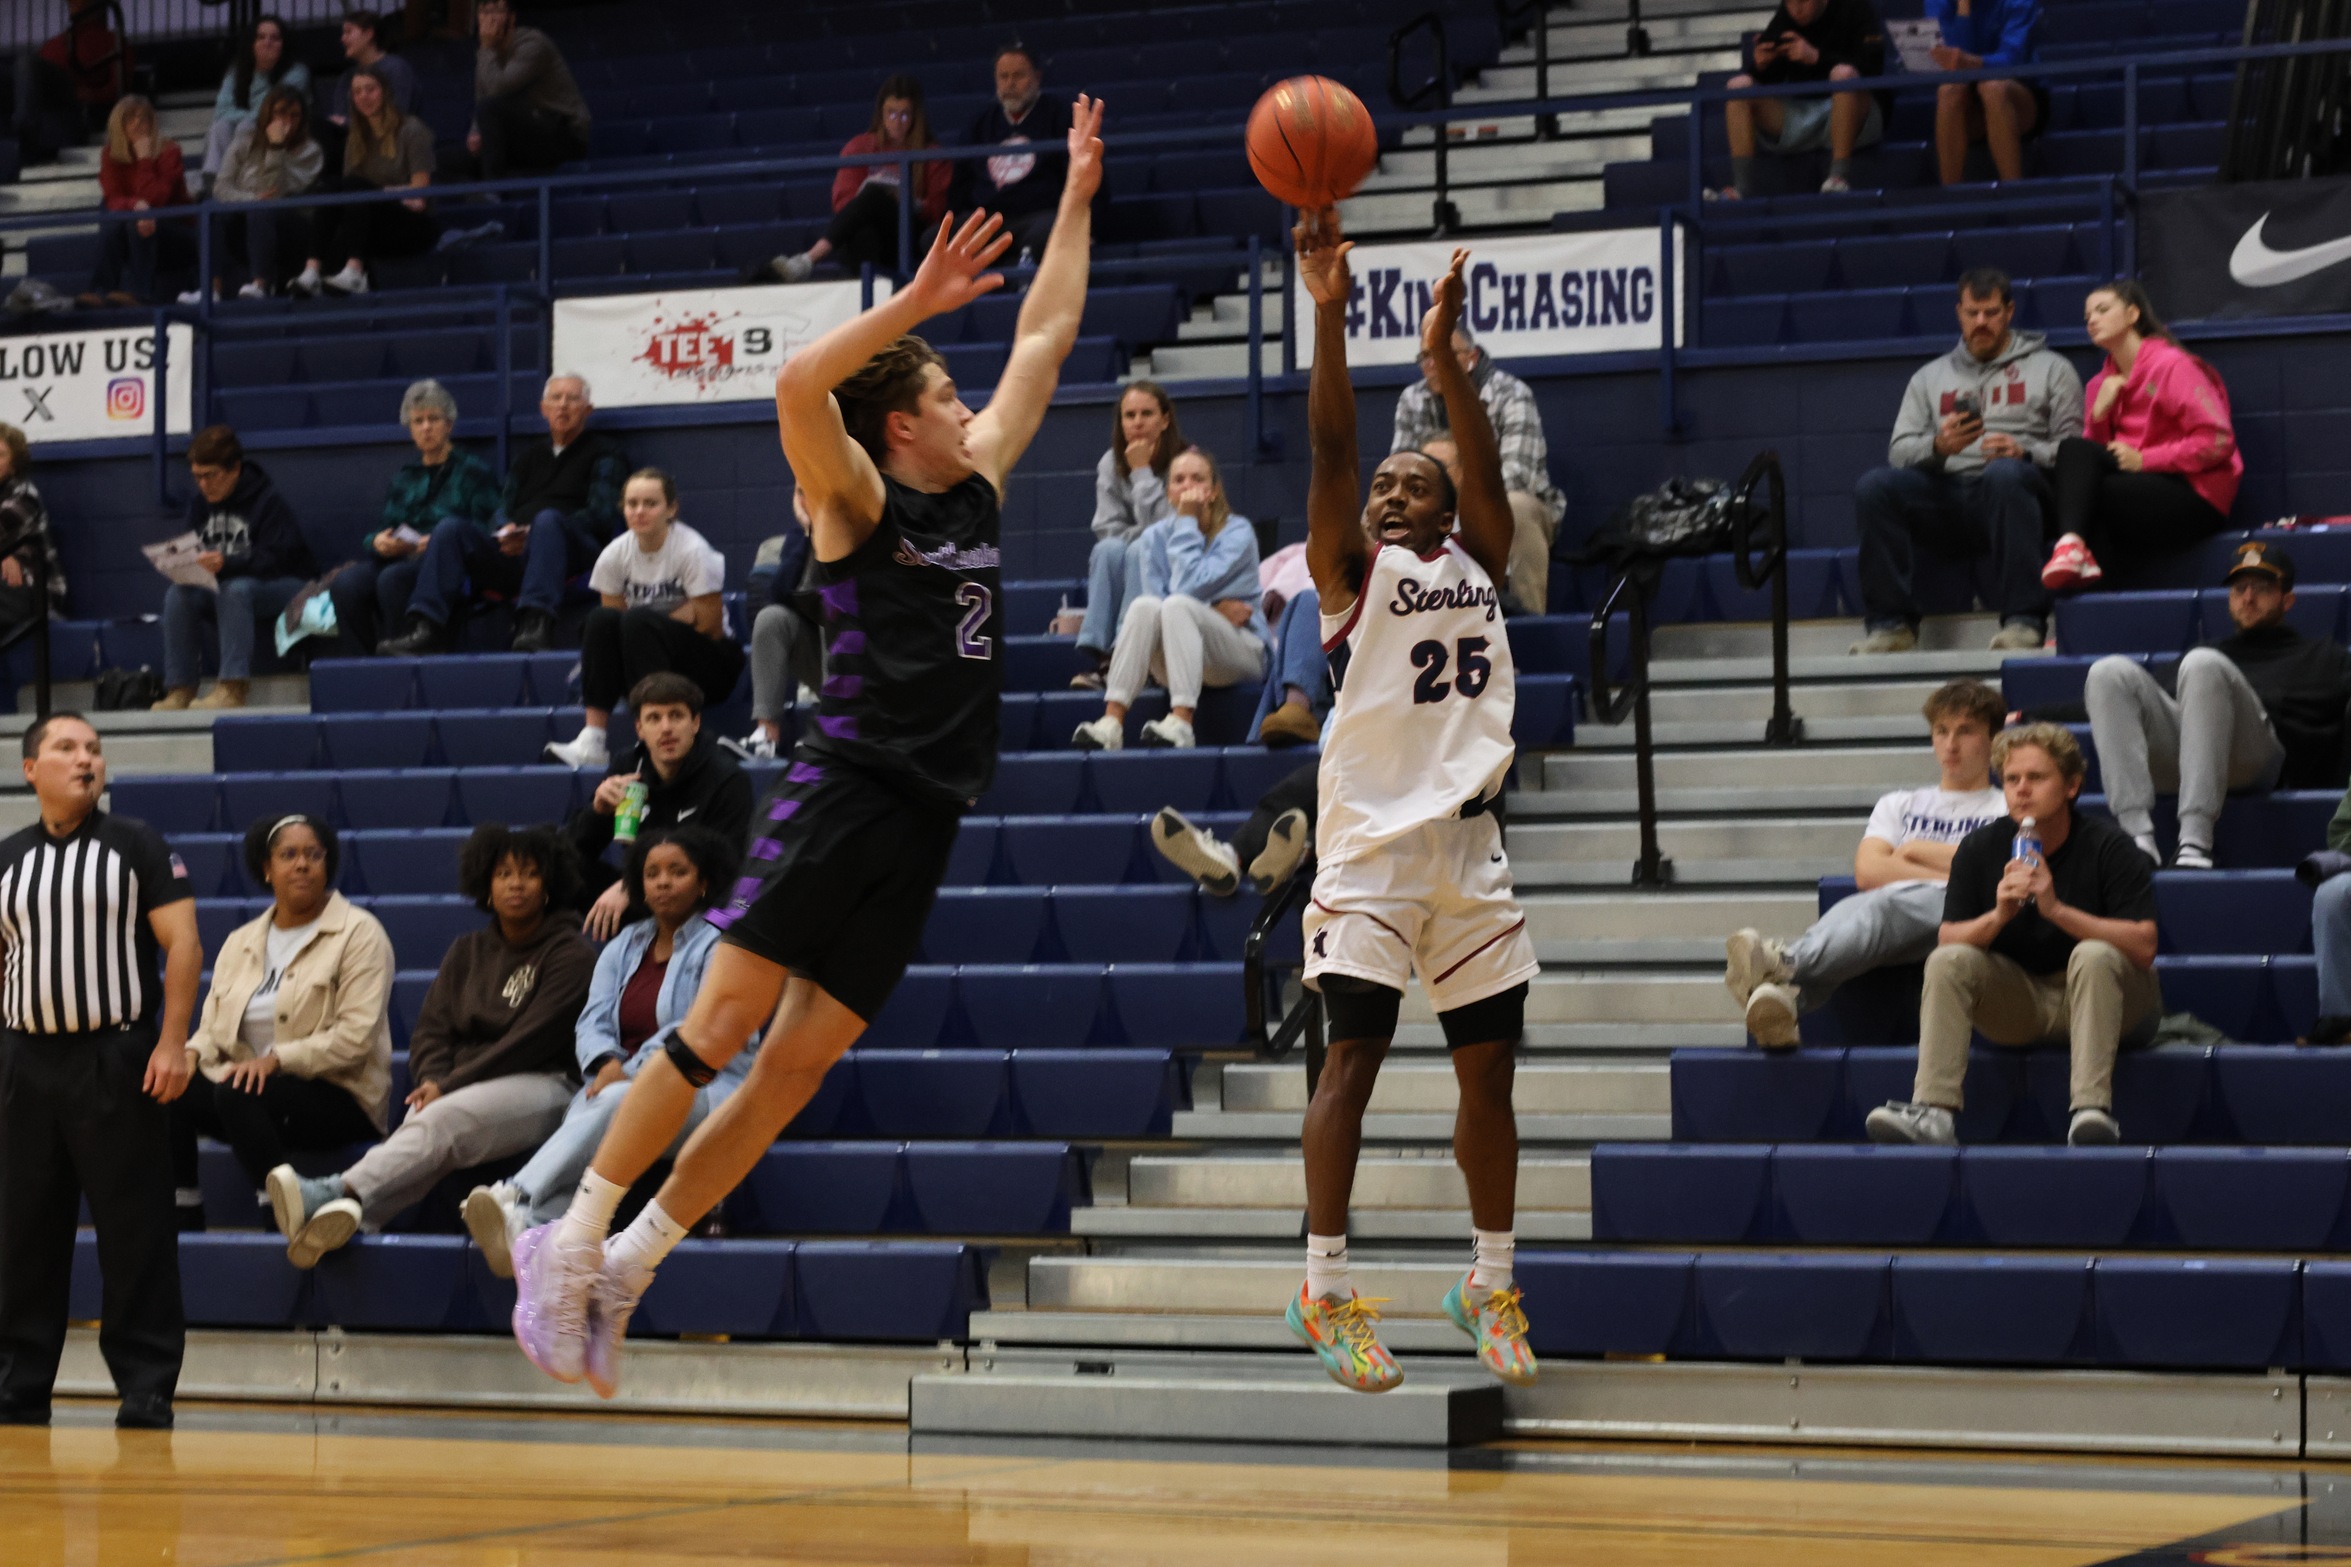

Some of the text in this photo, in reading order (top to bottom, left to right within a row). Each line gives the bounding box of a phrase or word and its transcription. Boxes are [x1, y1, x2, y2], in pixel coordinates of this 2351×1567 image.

[655, 331, 722, 363] TEE
[954, 581, 993, 661] 2
[1389, 577, 1498, 622] Sterling
[1410, 635, 1492, 705] 25
